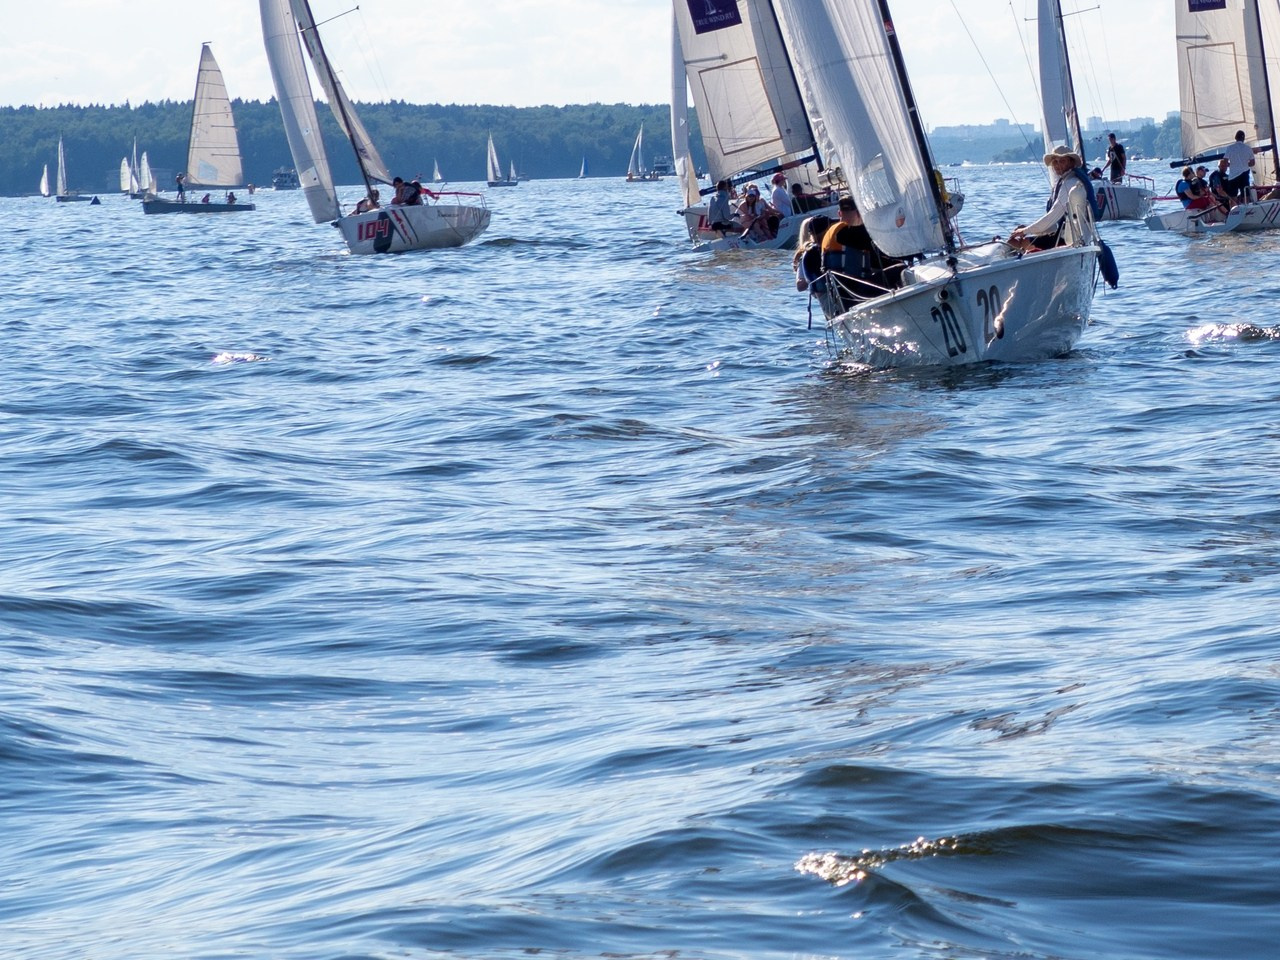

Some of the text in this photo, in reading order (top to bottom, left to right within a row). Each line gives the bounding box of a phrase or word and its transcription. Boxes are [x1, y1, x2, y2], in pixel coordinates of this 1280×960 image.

[357, 218, 390, 243] 104
[930, 302, 967, 358] 20
[976, 285, 1005, 344] 20
